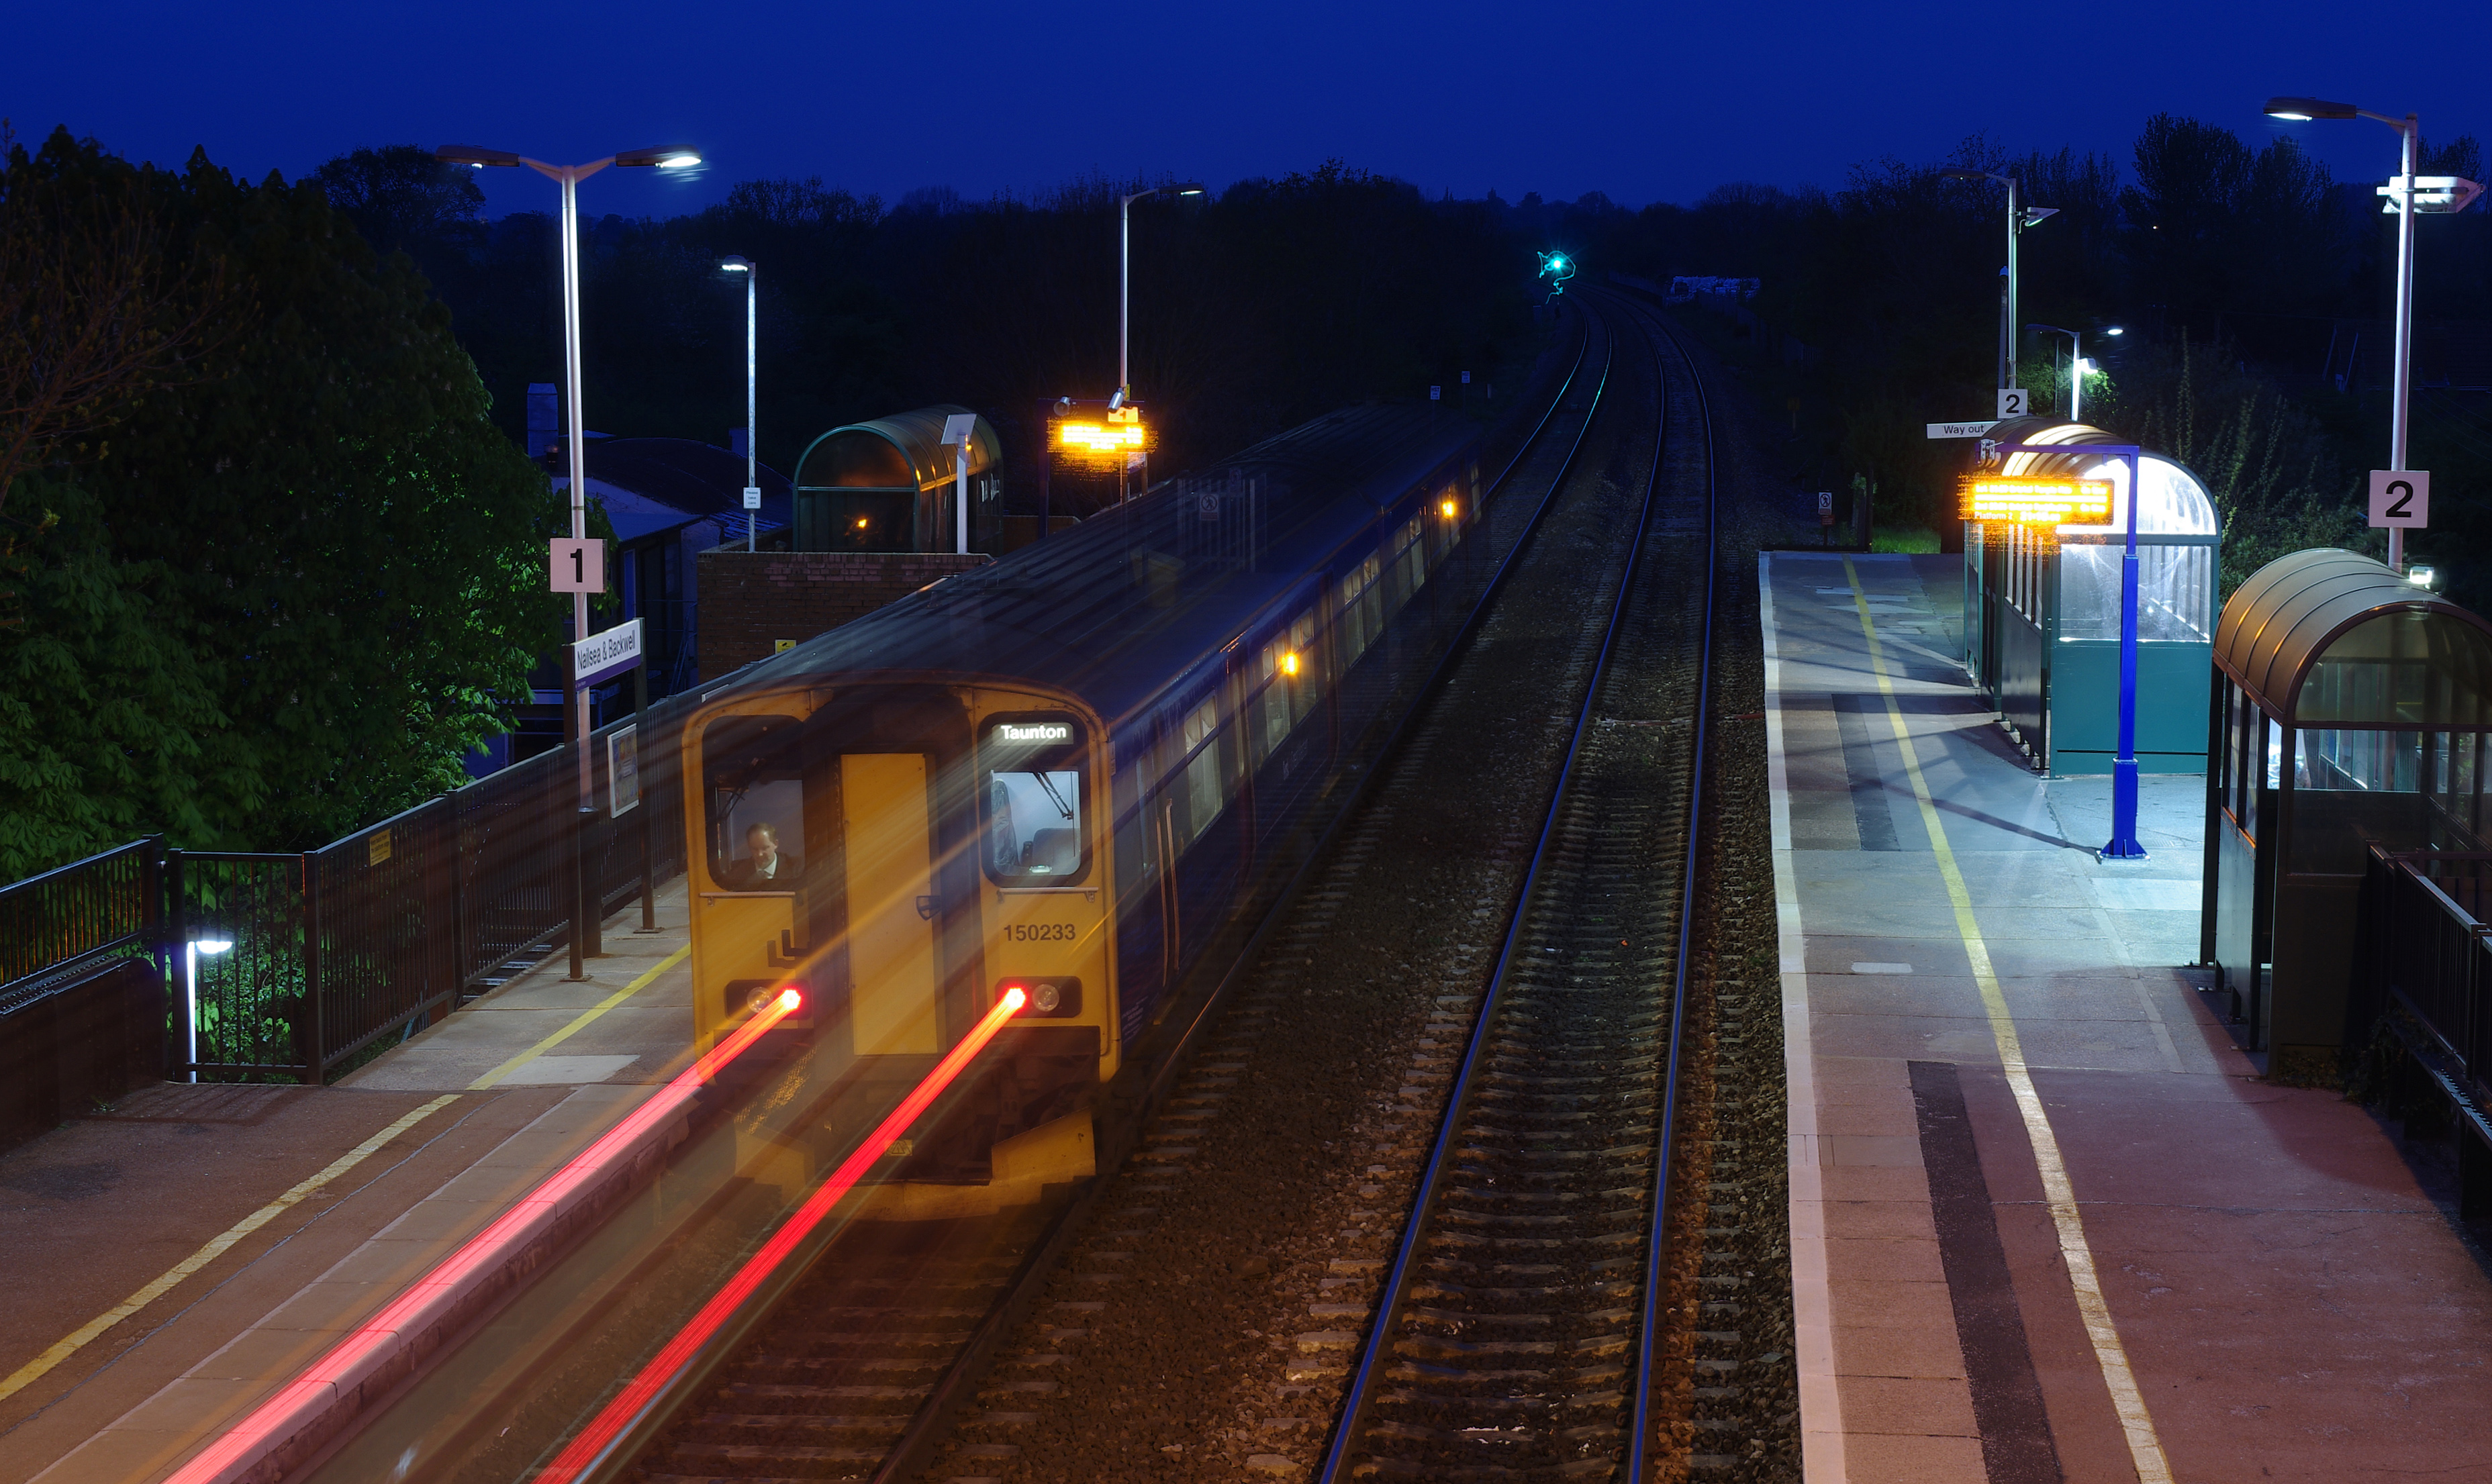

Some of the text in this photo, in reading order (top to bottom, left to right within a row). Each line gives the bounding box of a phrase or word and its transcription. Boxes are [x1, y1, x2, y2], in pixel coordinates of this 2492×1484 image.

[2006, 394, 2020, 413] 2
[1119, 410, 1127, 420] 1
[1944, 425, 1984, 435] Way out
[2386, 481, 2413, 517] 2
[1974, 511, 2007, 520] Platform
[571, 548, 583, 583] 1
[577, 630, 635, 671] Nailsea & Backwell
[1000, 725, 1067, 739] Taunton
[1004, 924, 1076, 941] 150233
